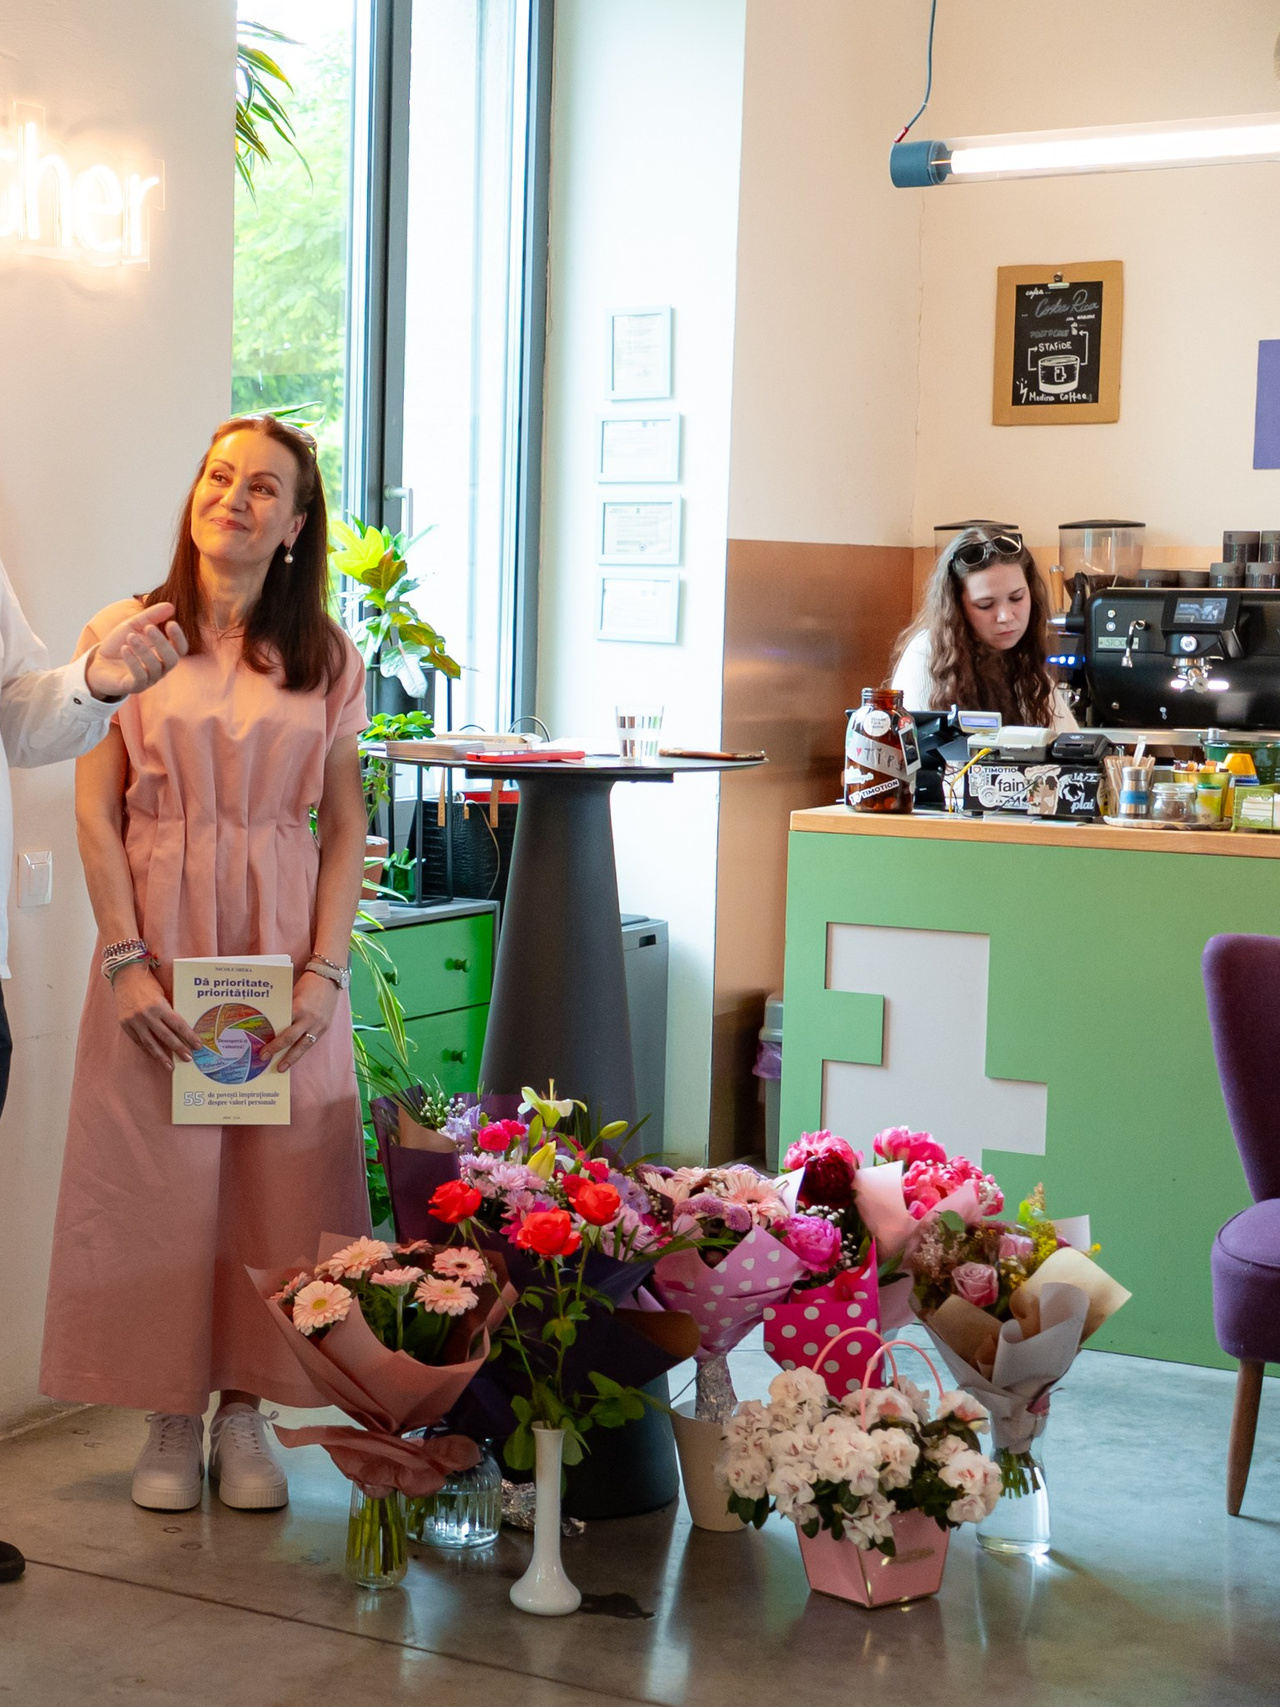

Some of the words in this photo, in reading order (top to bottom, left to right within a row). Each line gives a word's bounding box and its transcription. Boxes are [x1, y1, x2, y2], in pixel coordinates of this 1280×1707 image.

[1070, 289, 1099, 313] Rica
[862, 780, 899, 798] TIMOTION
[998, 778, 1025, 792] fain
[194, 977, 210, 986] Dă
[214, 978, 273, 990] prioritate,
[184, 1091, 205, 1107] 55
[208, 1099, 227, 1107] despre
